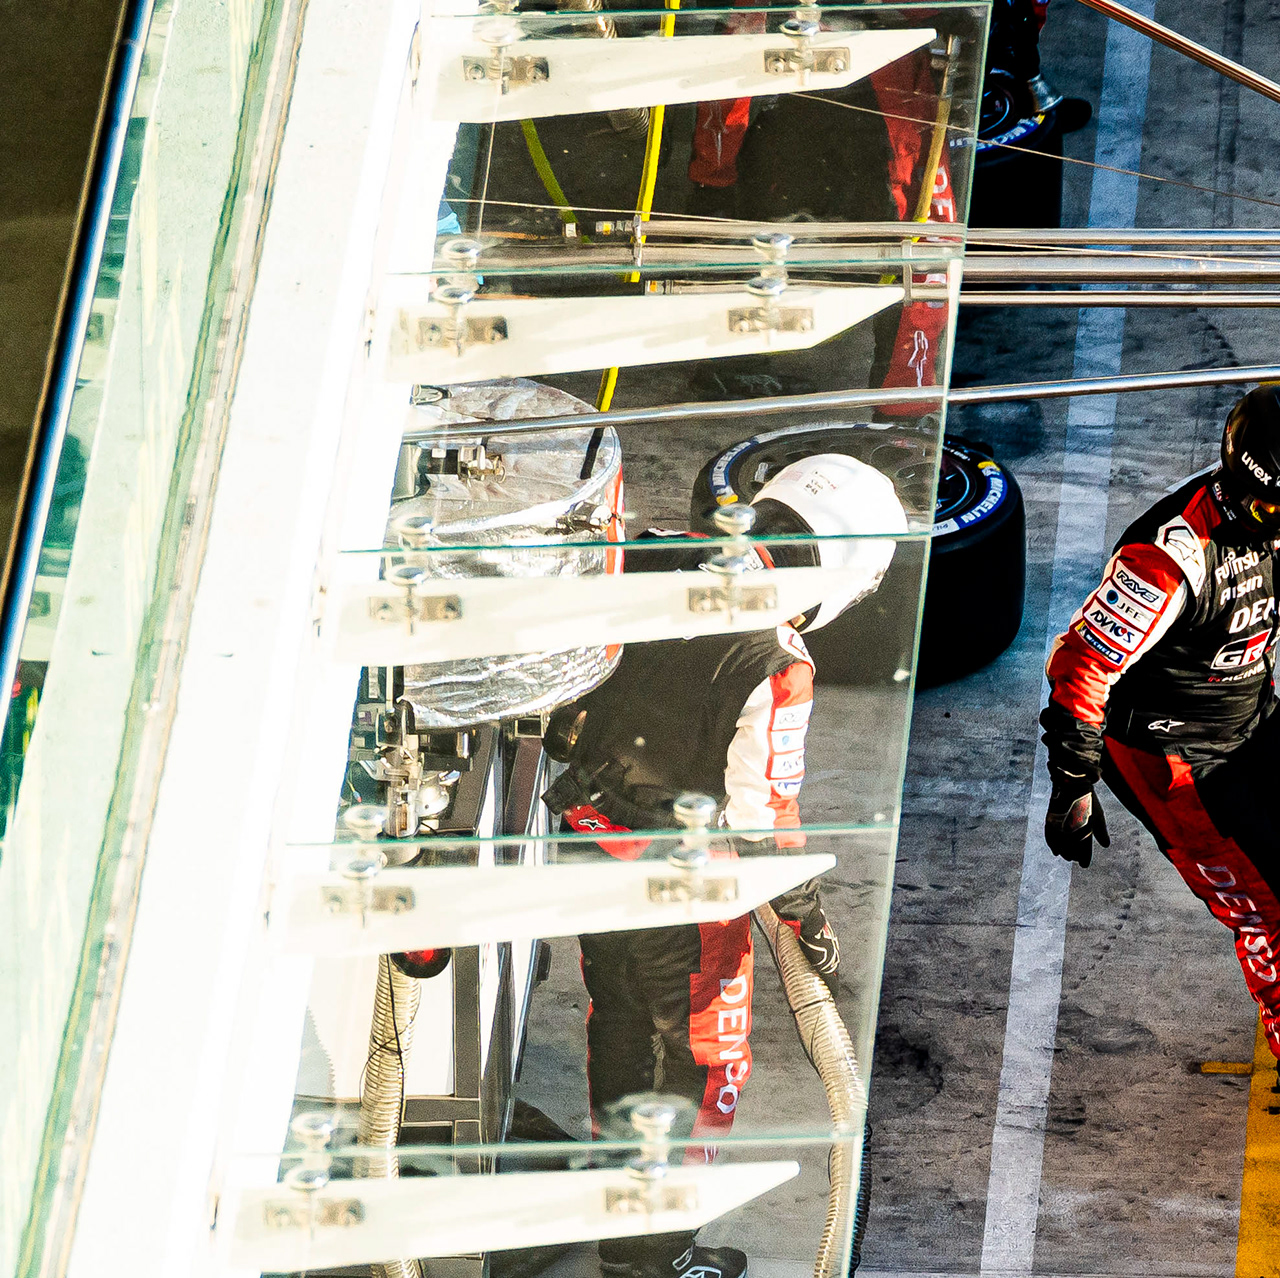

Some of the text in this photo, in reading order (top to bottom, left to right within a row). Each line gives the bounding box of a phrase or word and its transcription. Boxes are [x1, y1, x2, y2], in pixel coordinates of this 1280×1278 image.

[1241, 451, 1273, 486] uvex
[1117, 570, 1160, 603] RAYS
[1220, 574, 1263, 606] AISIN
[1117, 602, 1142, 621] JFE
[715, 974, 751, 1116] DENSO
